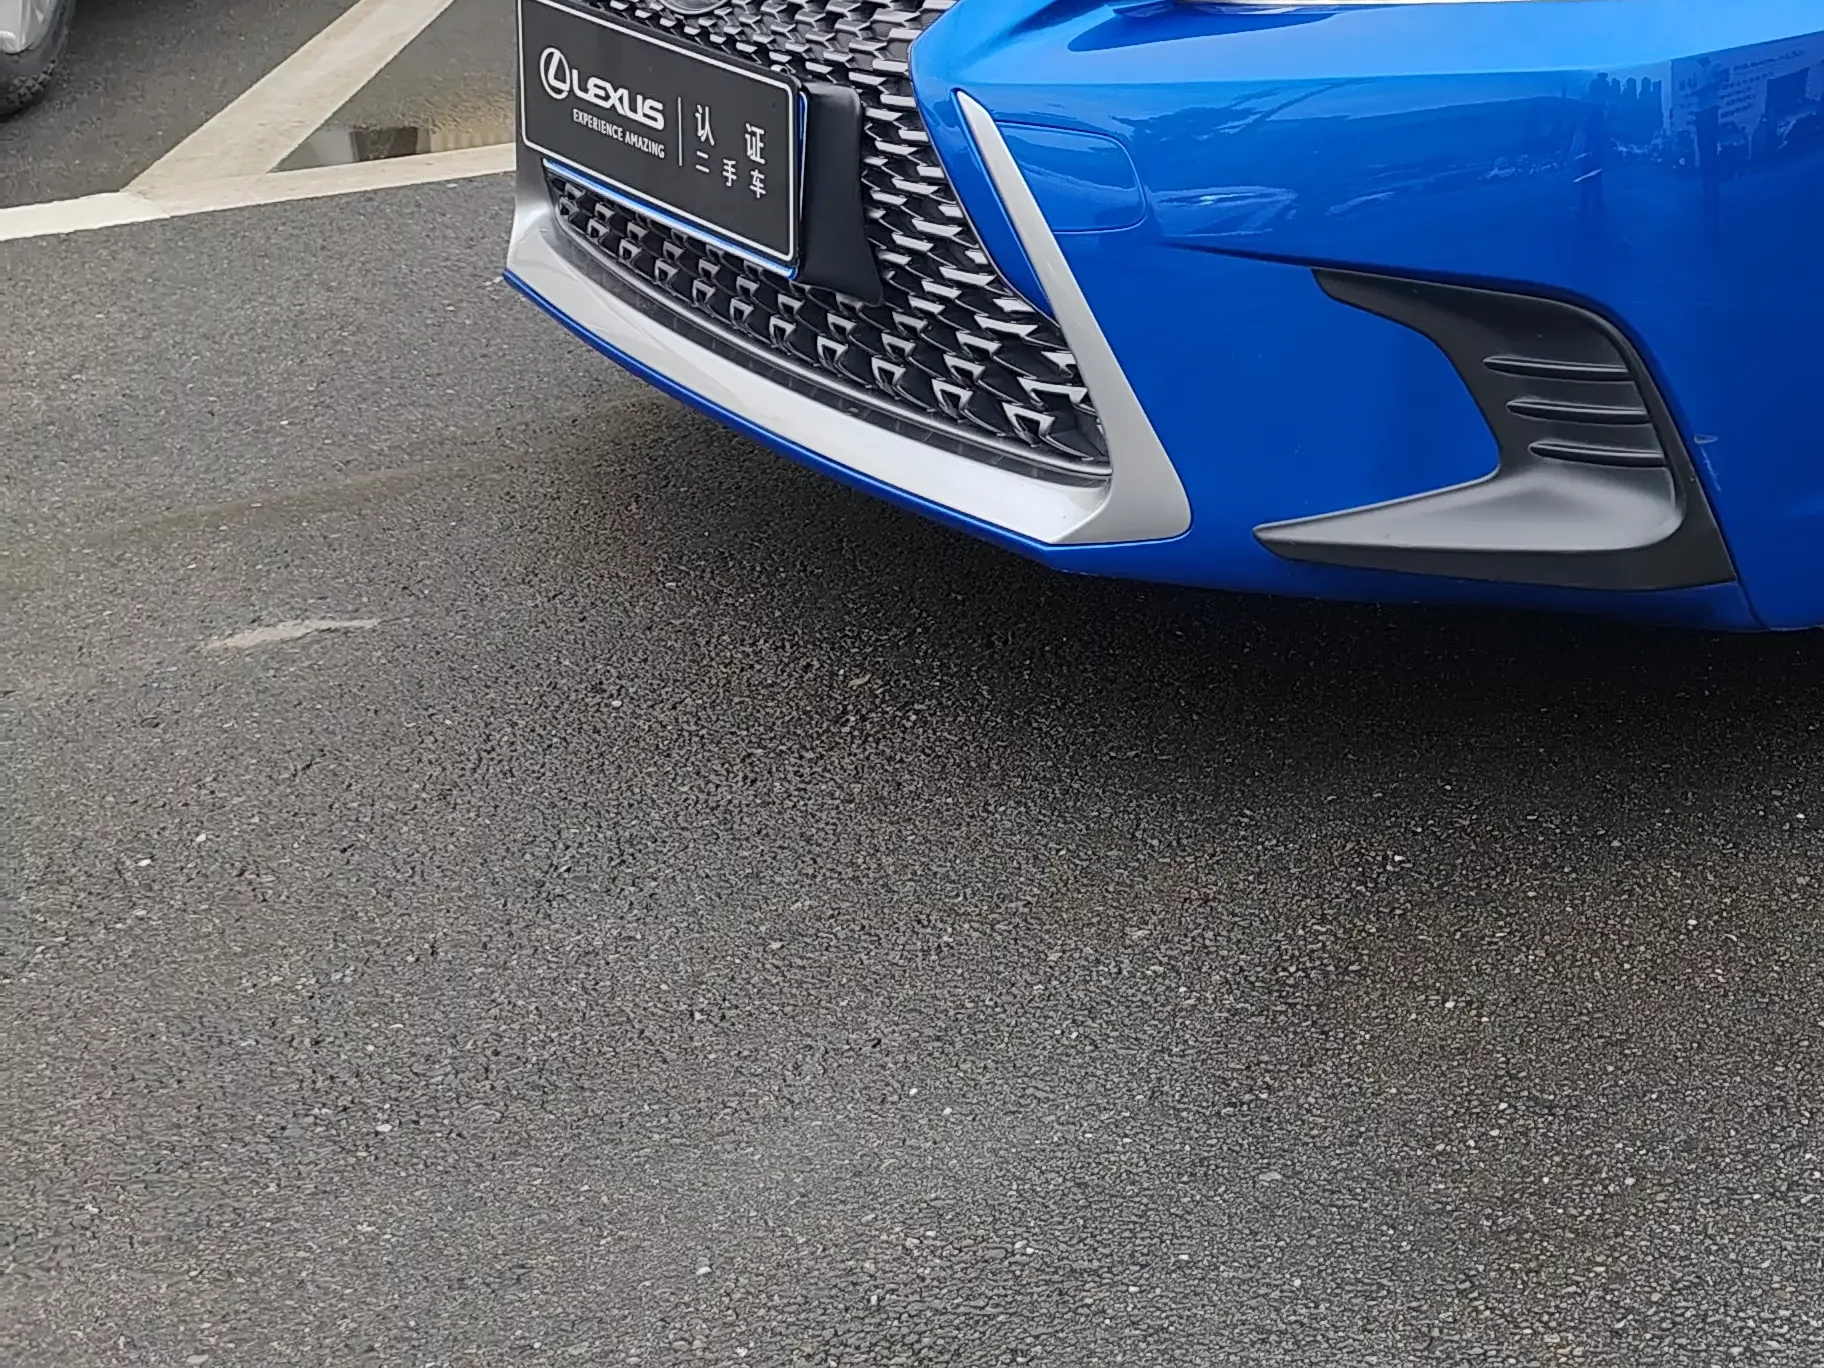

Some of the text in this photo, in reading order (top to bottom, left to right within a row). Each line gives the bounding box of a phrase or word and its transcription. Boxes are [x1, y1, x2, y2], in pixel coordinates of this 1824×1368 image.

[571, 68, 665, 131] LEXUS
[572, 108, 666, 159] EXPERIENCE AMAZING
[695, 150, 768, 199] 二手车
